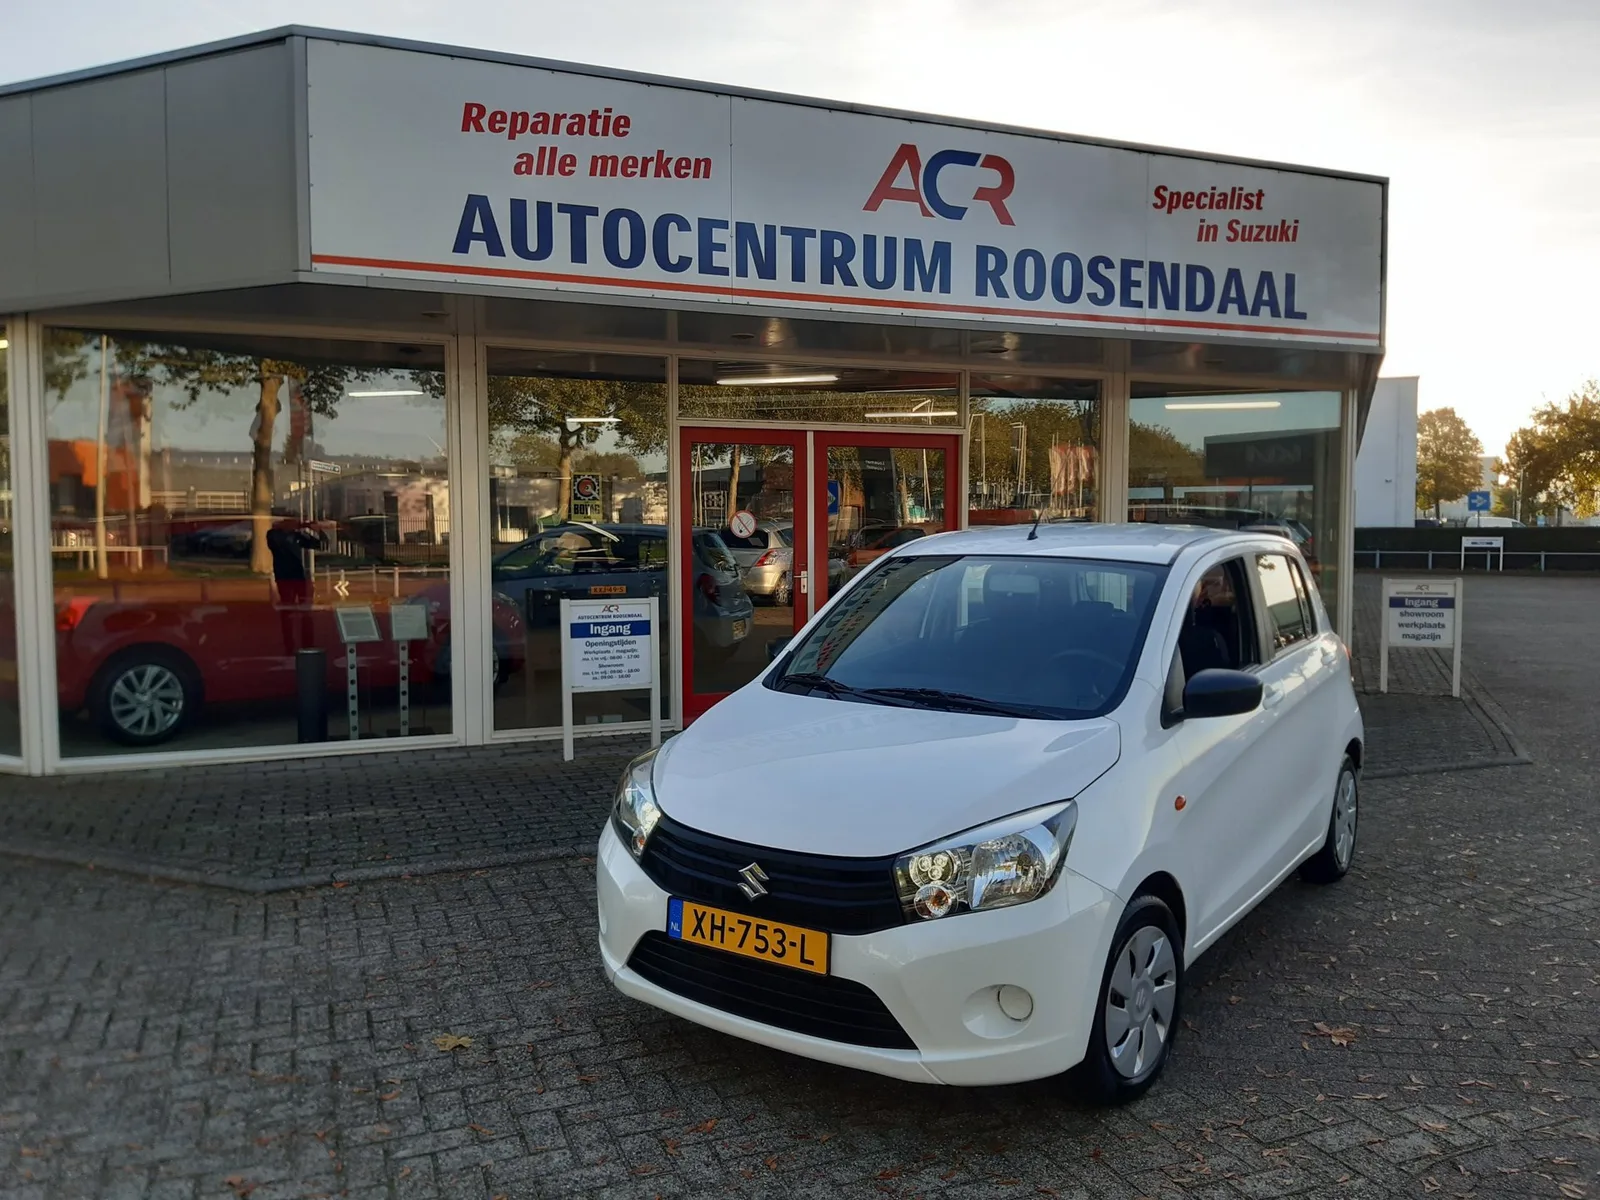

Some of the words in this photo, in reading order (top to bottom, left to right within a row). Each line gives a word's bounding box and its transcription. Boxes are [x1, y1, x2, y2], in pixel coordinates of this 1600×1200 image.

[461, 102, 632, 140] Reparatie
[513, 146, 577, 176] alle
[589, 149, 712, 179] merken
[862, 143, 1017, 226] ACR
[1152, 185, 1265, 214] Specialist
[1197, 218, 1218, 243] in
[1226, 219, 1299, 243] Suzuki
[452, 193, 952, 294] AUTOCENTRUM
[975, 244, 1307, 320] ROOSENDAAL
[602, 604, 620, 613] ACR
[1405, 598, 1439, 608] Ingang
[1399, 610, 1444, 618] showroom
[590, 624, 631, 636] Ingang
[1398, 621, 1446, 629] werkplaats
[585, 640, 636, 648] Openingstijden
[1402, 632, 1441, 641] magazijn
[670, 921, 680, 932] NL
[691, 908, 815, 966] XH-753-L
